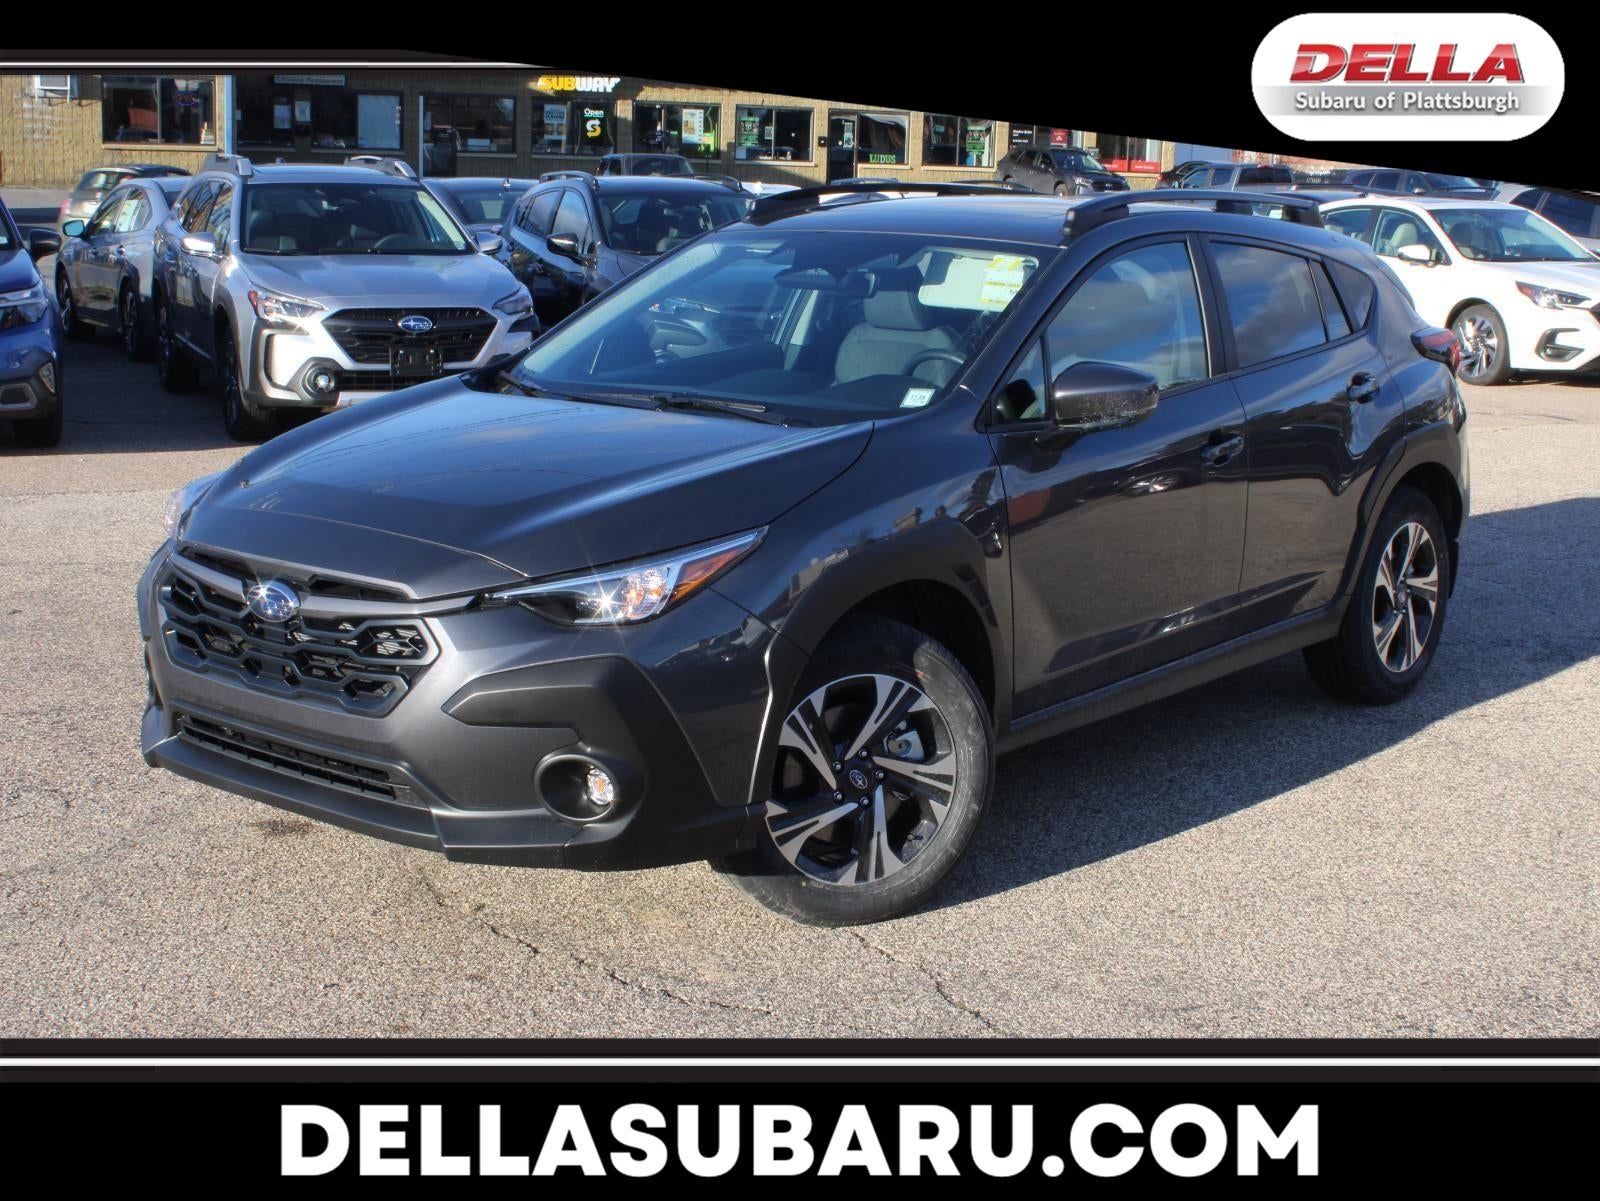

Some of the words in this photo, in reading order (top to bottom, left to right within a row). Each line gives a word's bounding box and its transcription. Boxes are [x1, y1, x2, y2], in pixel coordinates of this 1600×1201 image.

[538, 75, 620, 92] SUBWAY
[584, 108, 604, 117] Open
[869, 154, 896, 163] LUDUS
